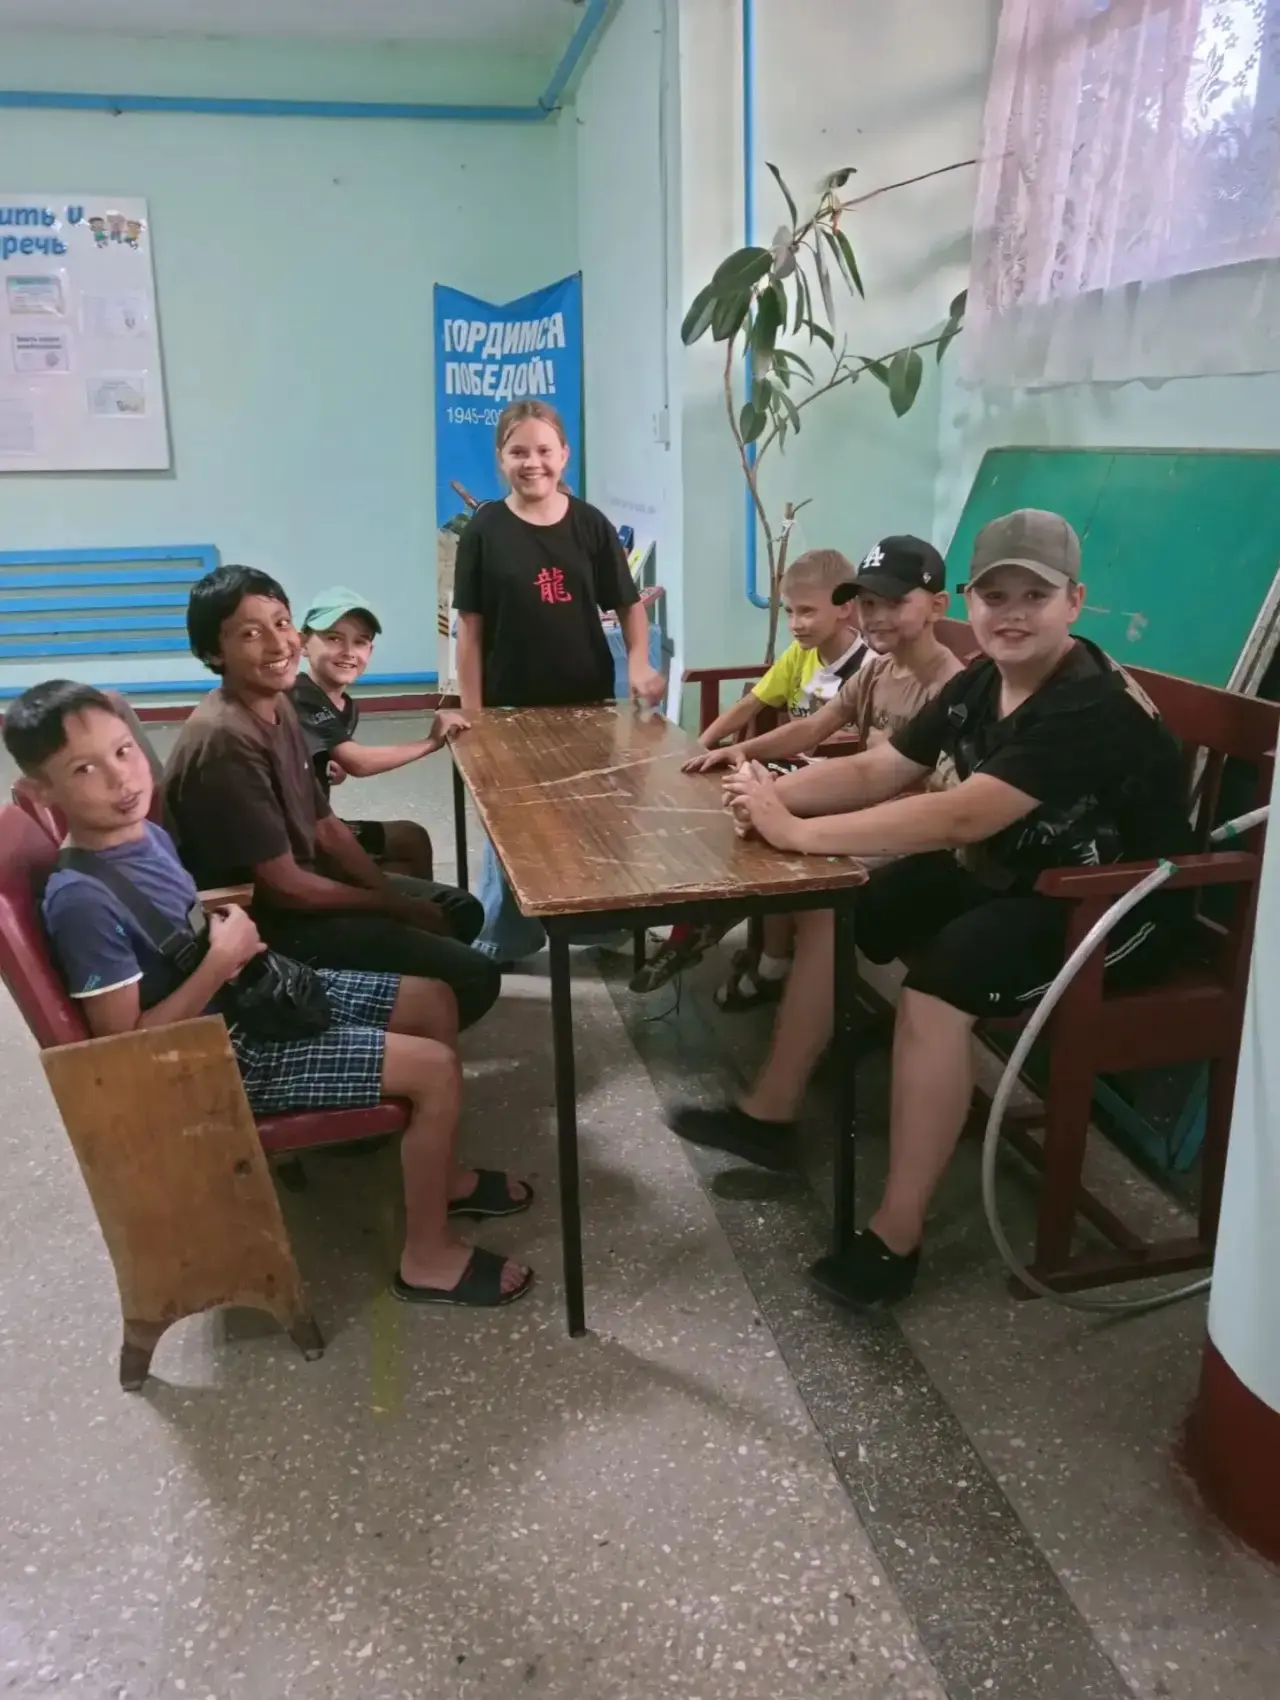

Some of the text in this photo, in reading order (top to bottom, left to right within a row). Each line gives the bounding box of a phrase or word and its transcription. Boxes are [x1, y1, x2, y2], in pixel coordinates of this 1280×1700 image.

[2, 235, 68, 260] речь
[443, 311, 566, 360] ГОРДИМСЯ
[445, 355, 556, 402] ПОБЕДОЙ!
[862, 542, 886, 569] LA
[533, 567, 572, 604] 龍
